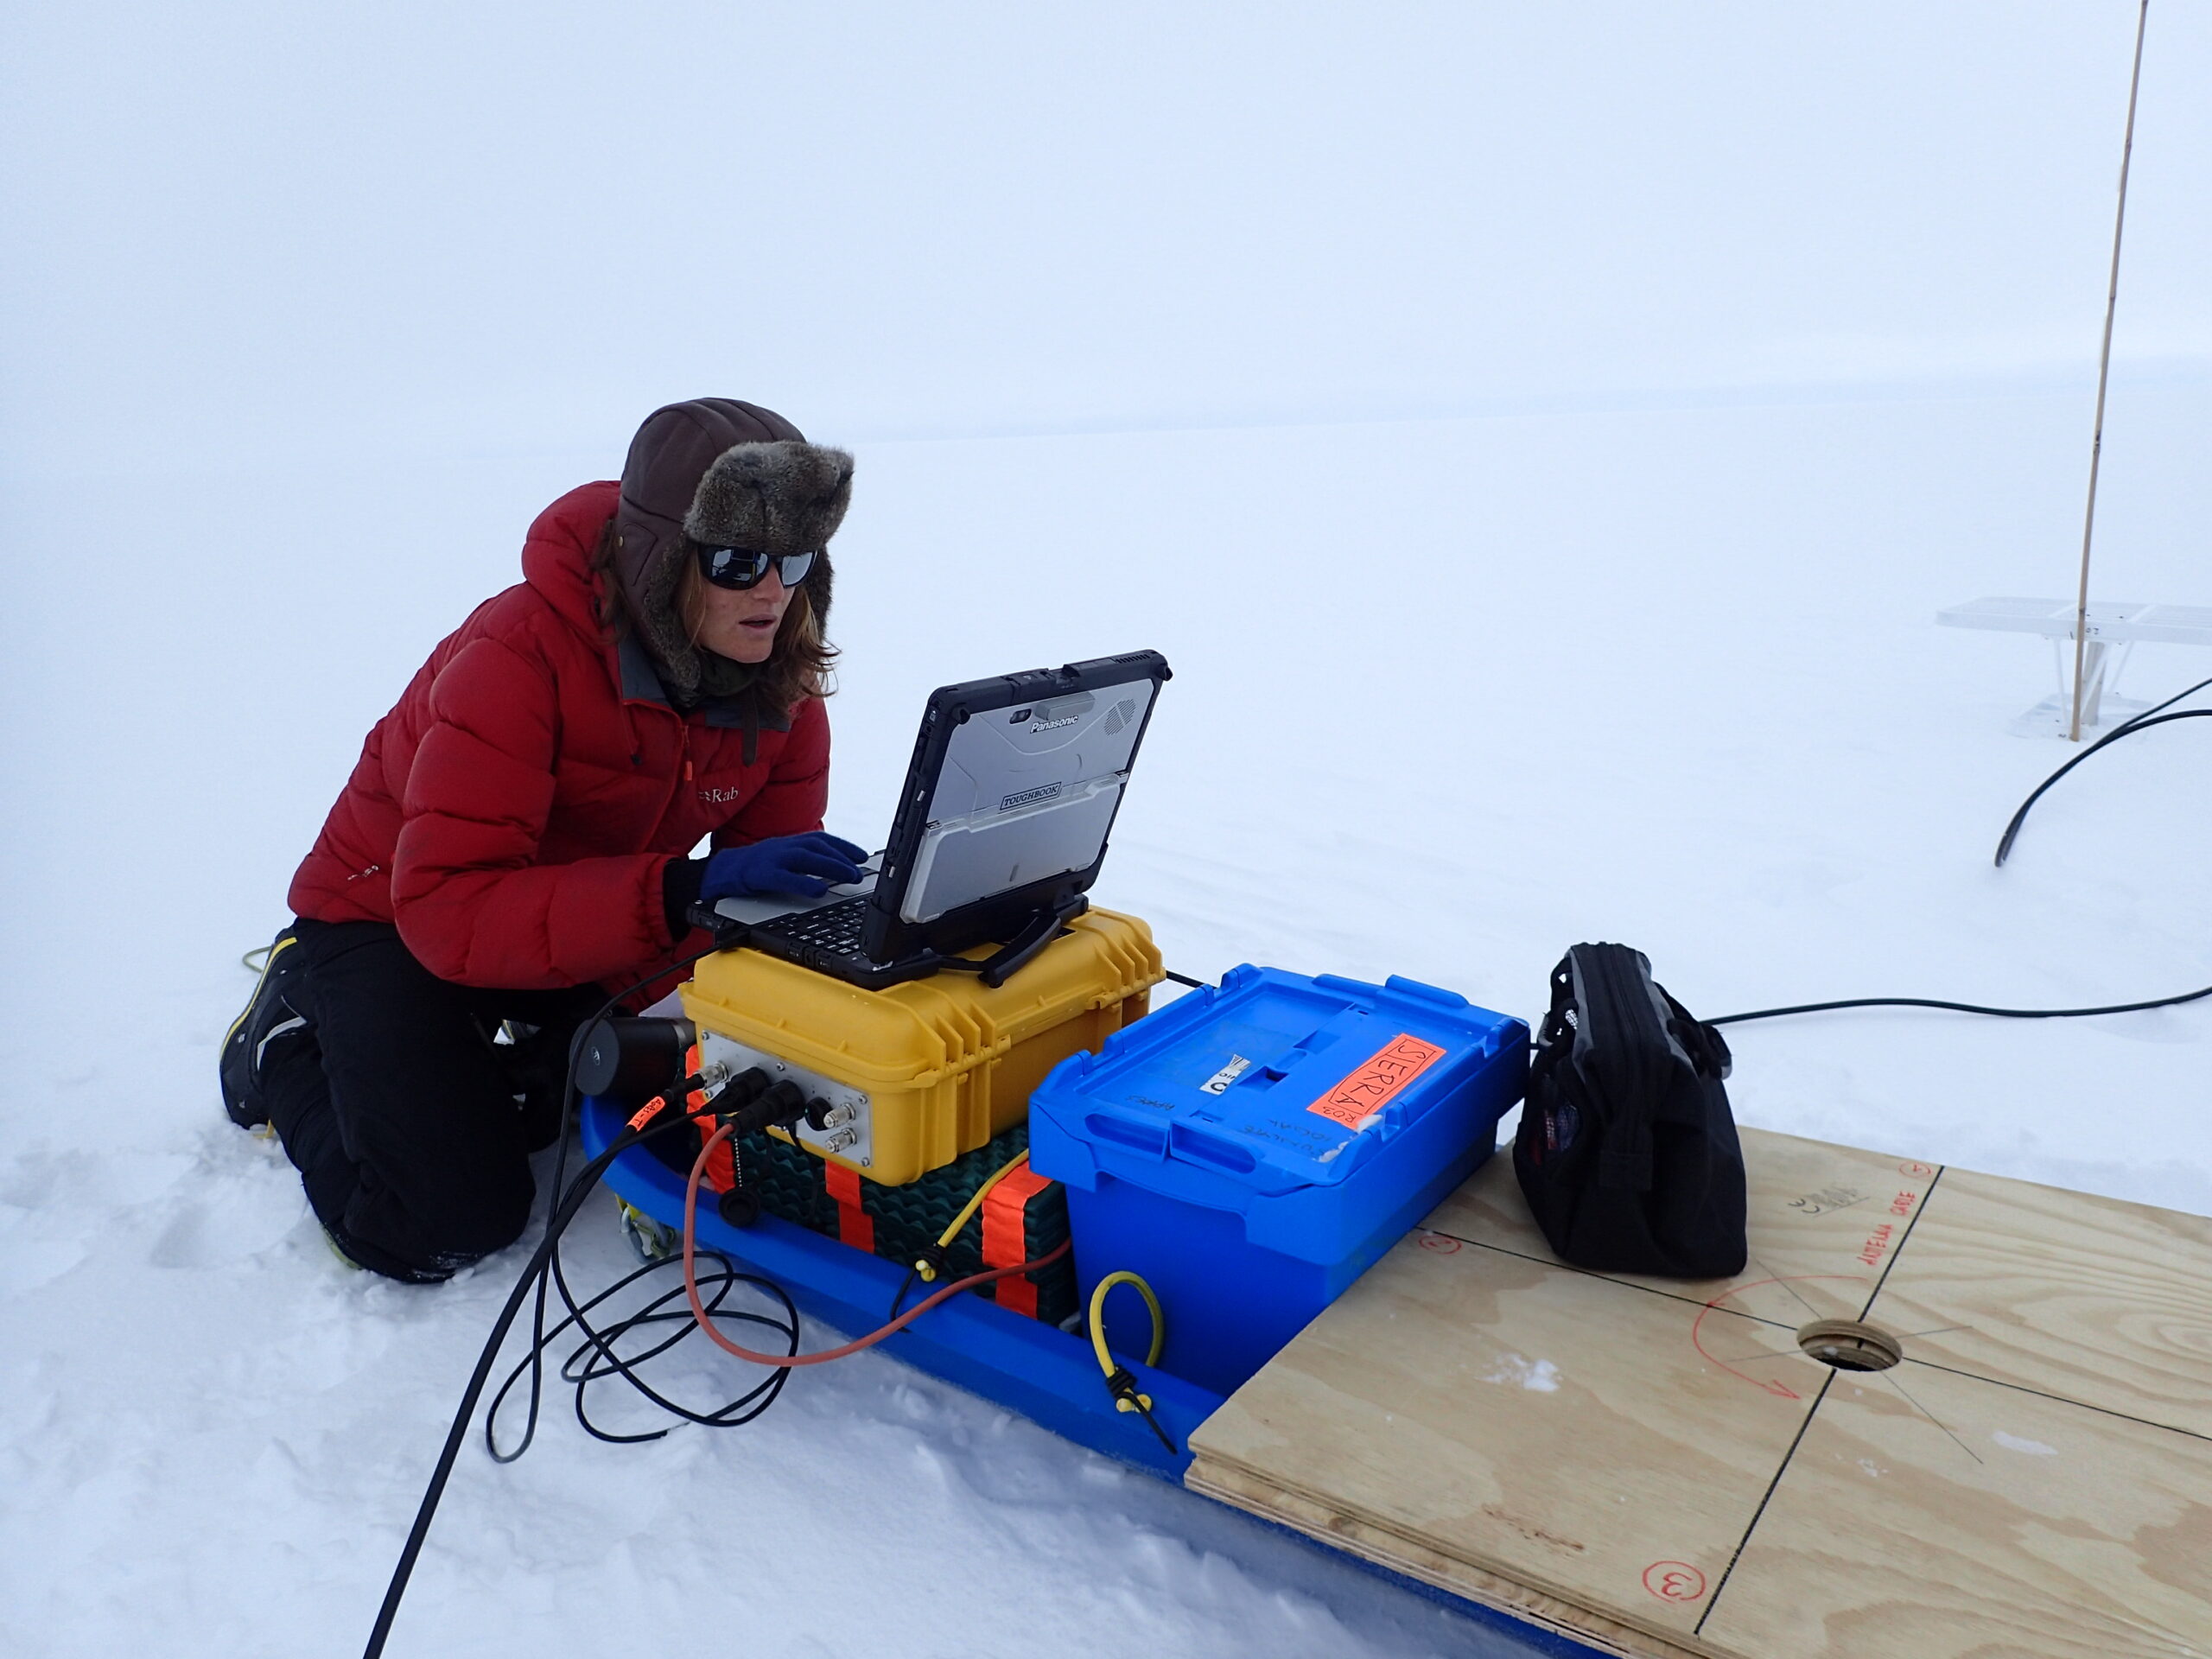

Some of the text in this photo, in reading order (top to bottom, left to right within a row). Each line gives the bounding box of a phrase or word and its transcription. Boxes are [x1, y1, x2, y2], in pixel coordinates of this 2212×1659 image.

[1030, 715, 1078, 734] Panasonic
[712, 786, 739, 803] Rab
[1004, 785, 1058, 806] TOUGHBOOK
[1336, 1045, 1427, 1108] SIERRA
